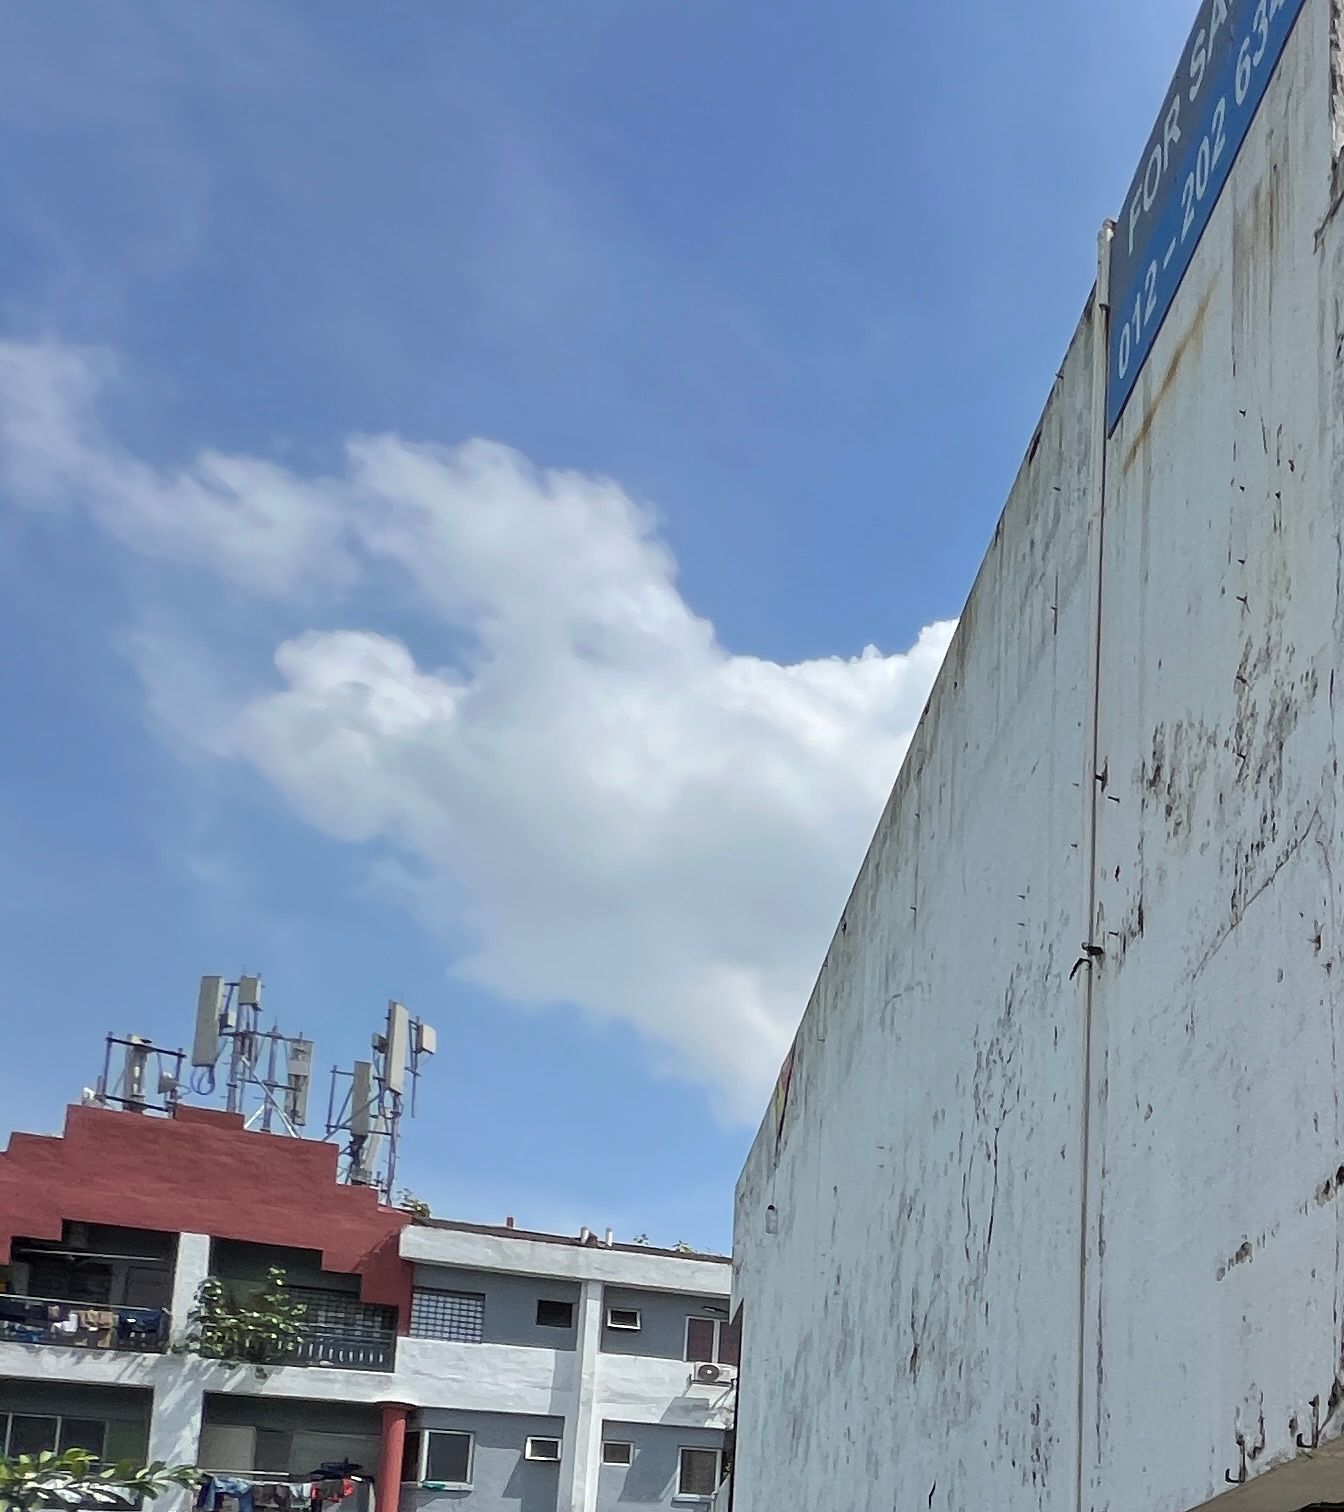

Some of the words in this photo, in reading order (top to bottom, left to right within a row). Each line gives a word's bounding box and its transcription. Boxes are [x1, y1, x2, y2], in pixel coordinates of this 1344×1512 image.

[1118, 259, 1158, 380] 012
[1180, 97, 1227, 245] 202
[1128, 95, 1183, 256] FOR
[1188, 0, 1236, 102] SA
